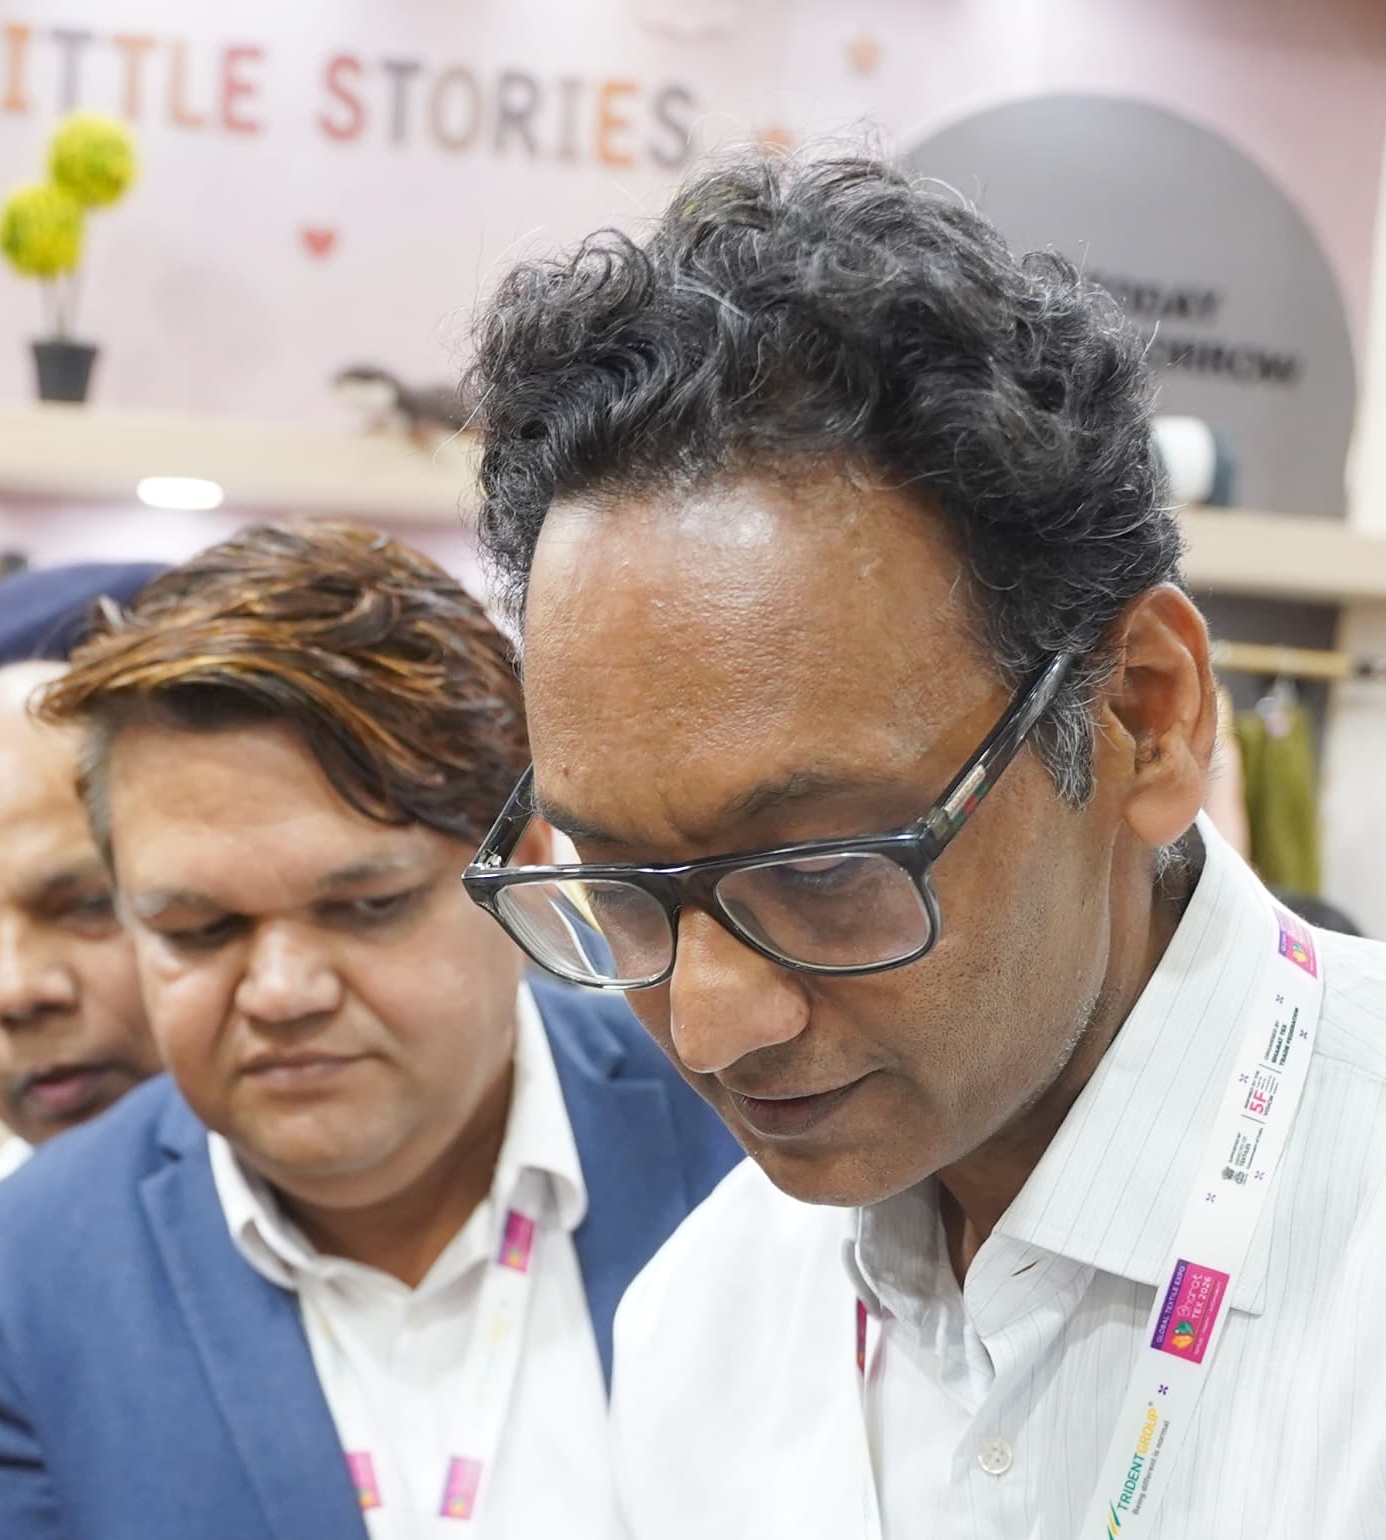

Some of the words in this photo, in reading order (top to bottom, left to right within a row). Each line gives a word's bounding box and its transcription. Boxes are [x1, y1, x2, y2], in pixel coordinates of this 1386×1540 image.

[319, 55, 700, 169] STORIES
[1157, 1314, 1171, 1344] GLOBAL
[1165, 1285, 1180, 1315] TEXTILE
[1174, 1265, 1186, 1287] EXPO
[1191, 1300, 1203, 1319] TEX
[1198, 1274, 1212, 1299] 2026
[1117, 1453, 1145, 1512] TRIDENT
[1137, 1408, 1158, 1454] GROUP
[1132, 1491, 1148, 1516] Being
[1141, 1456, 1157, 1492] different
[1156, 1420, 1170, 1448] normal
